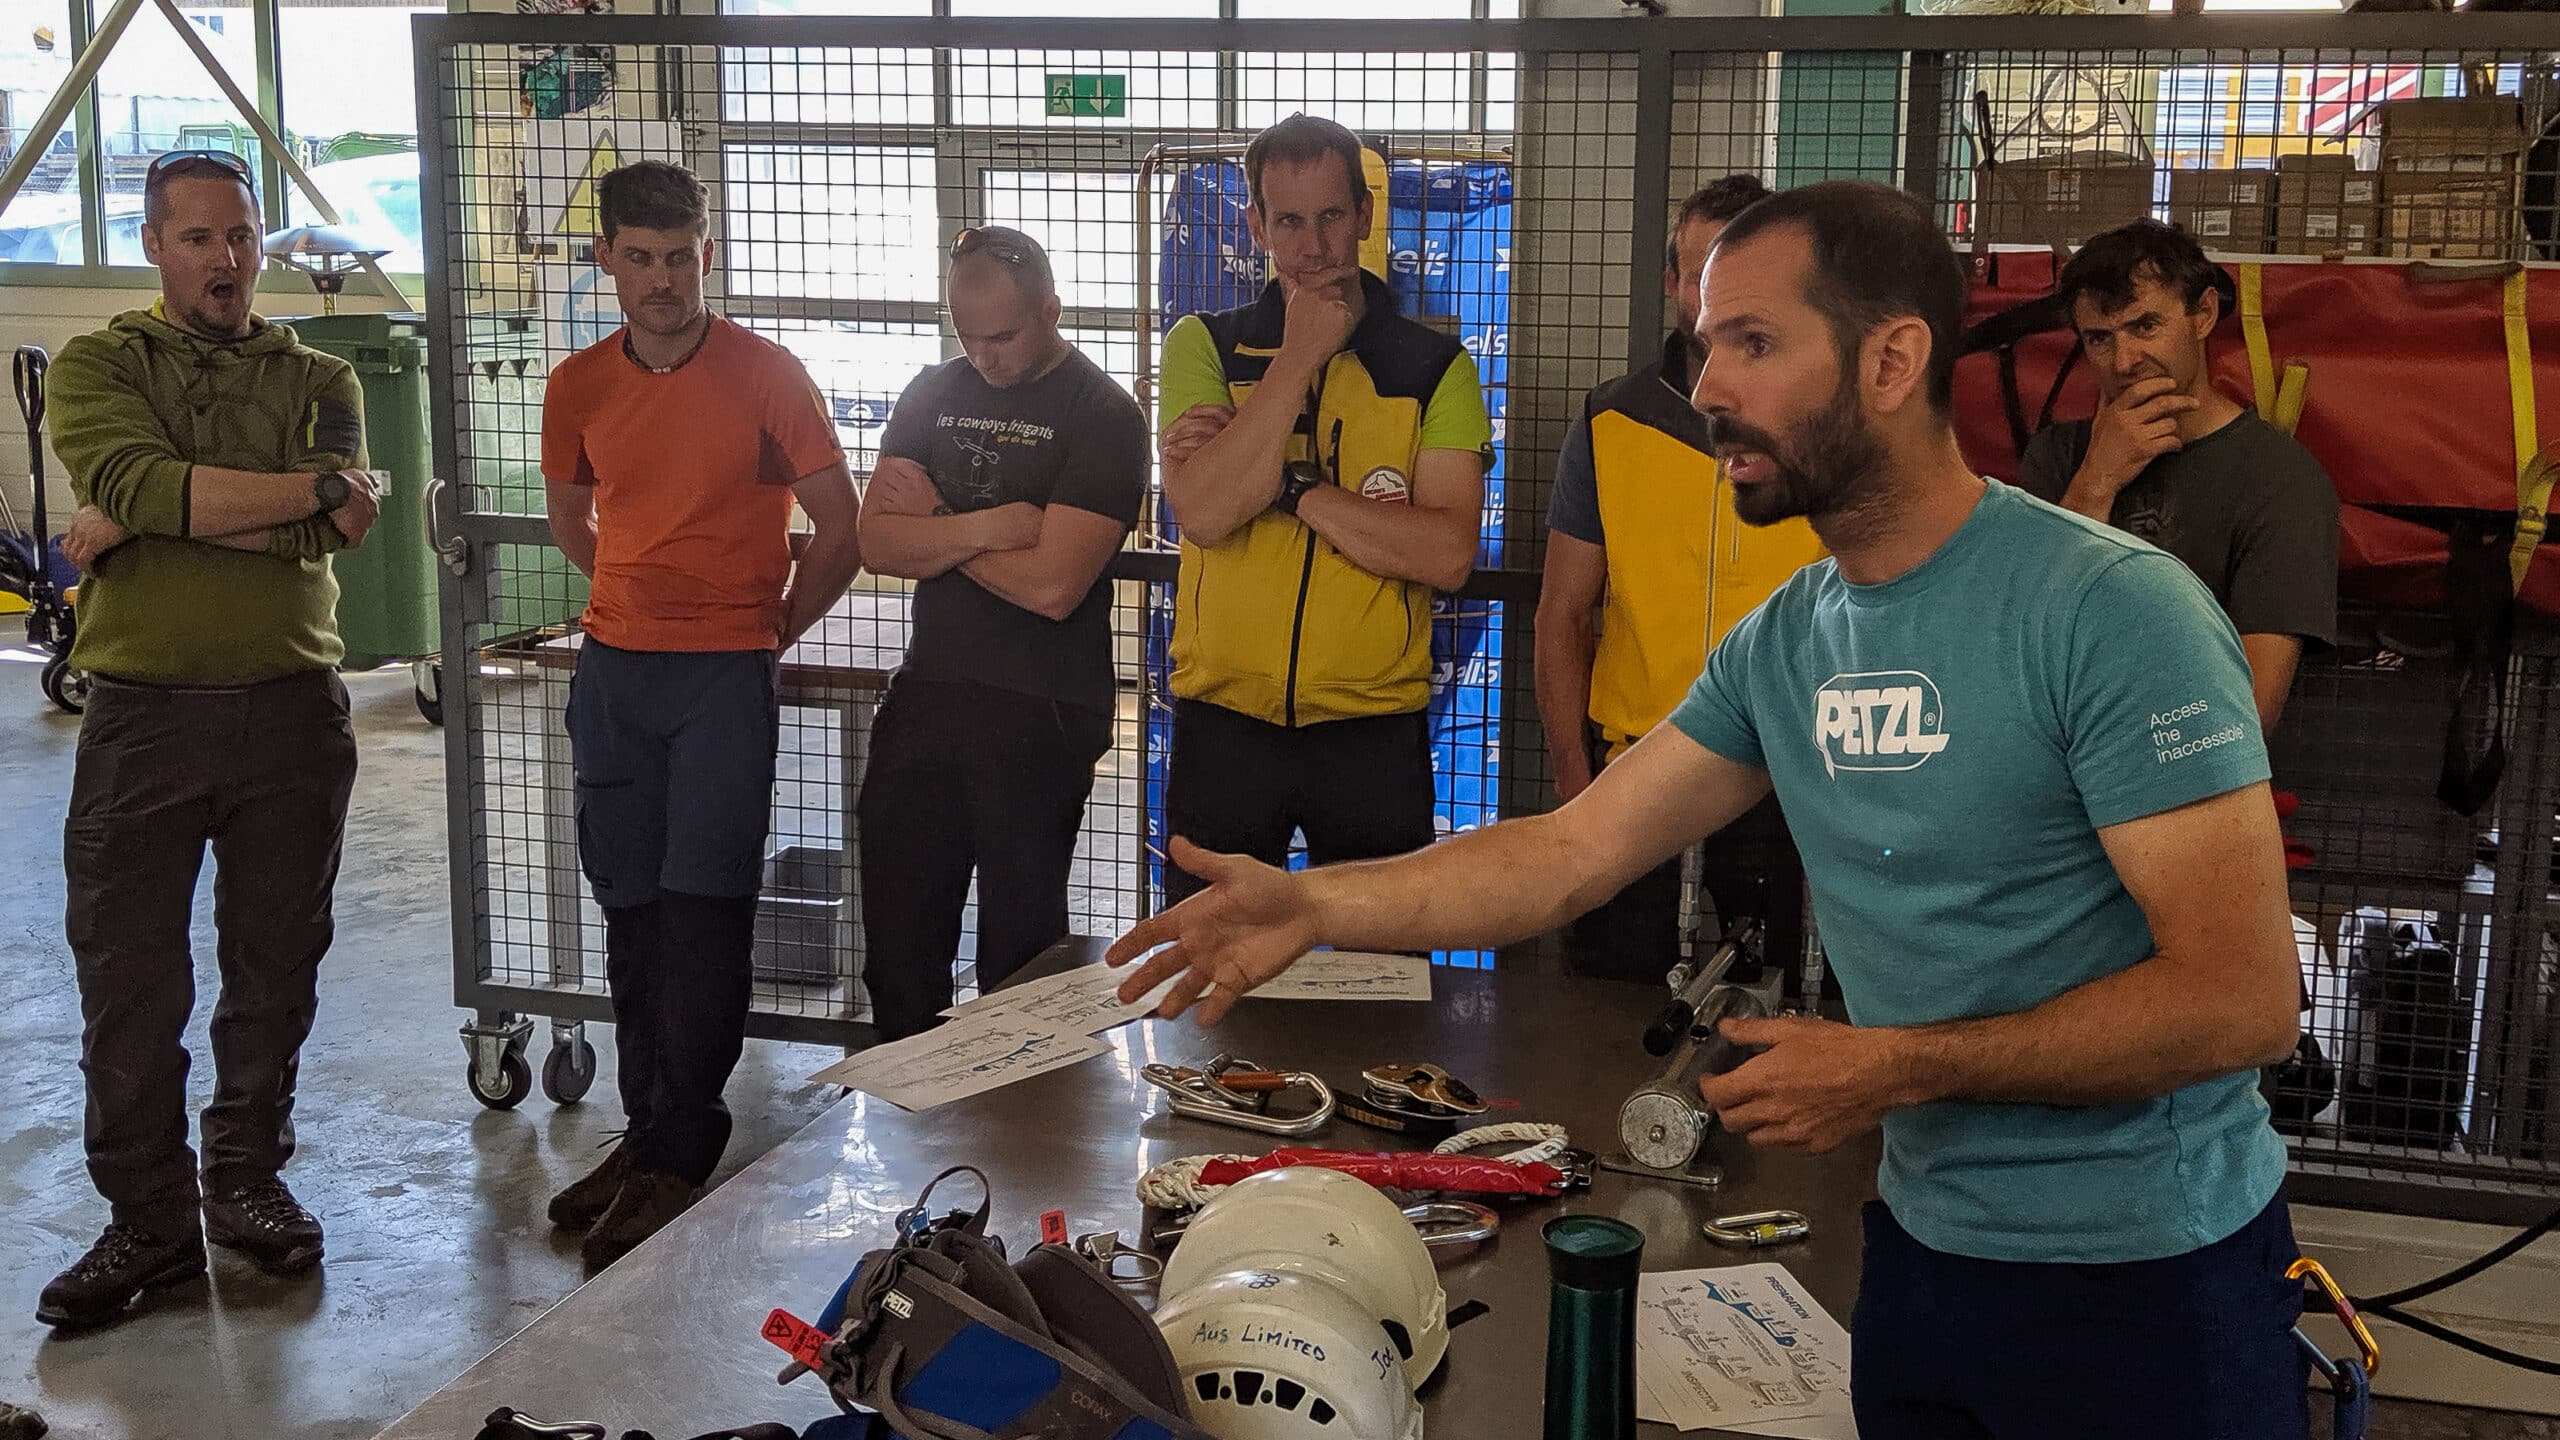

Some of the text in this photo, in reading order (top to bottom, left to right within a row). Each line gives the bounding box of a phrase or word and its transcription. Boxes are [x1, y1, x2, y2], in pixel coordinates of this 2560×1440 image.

[936, 413, 955, 427] les
[957, 417, 1008, 434] cowboys
[1816, 686, 1950, 756] PETZL
[2150, 699, 2208, 730] Access
[2152, 728, 2181, 746] the
[884, 1289, 913, 1319] PETZL
[1764, 1274, 1813, 1322] PREPARATION
